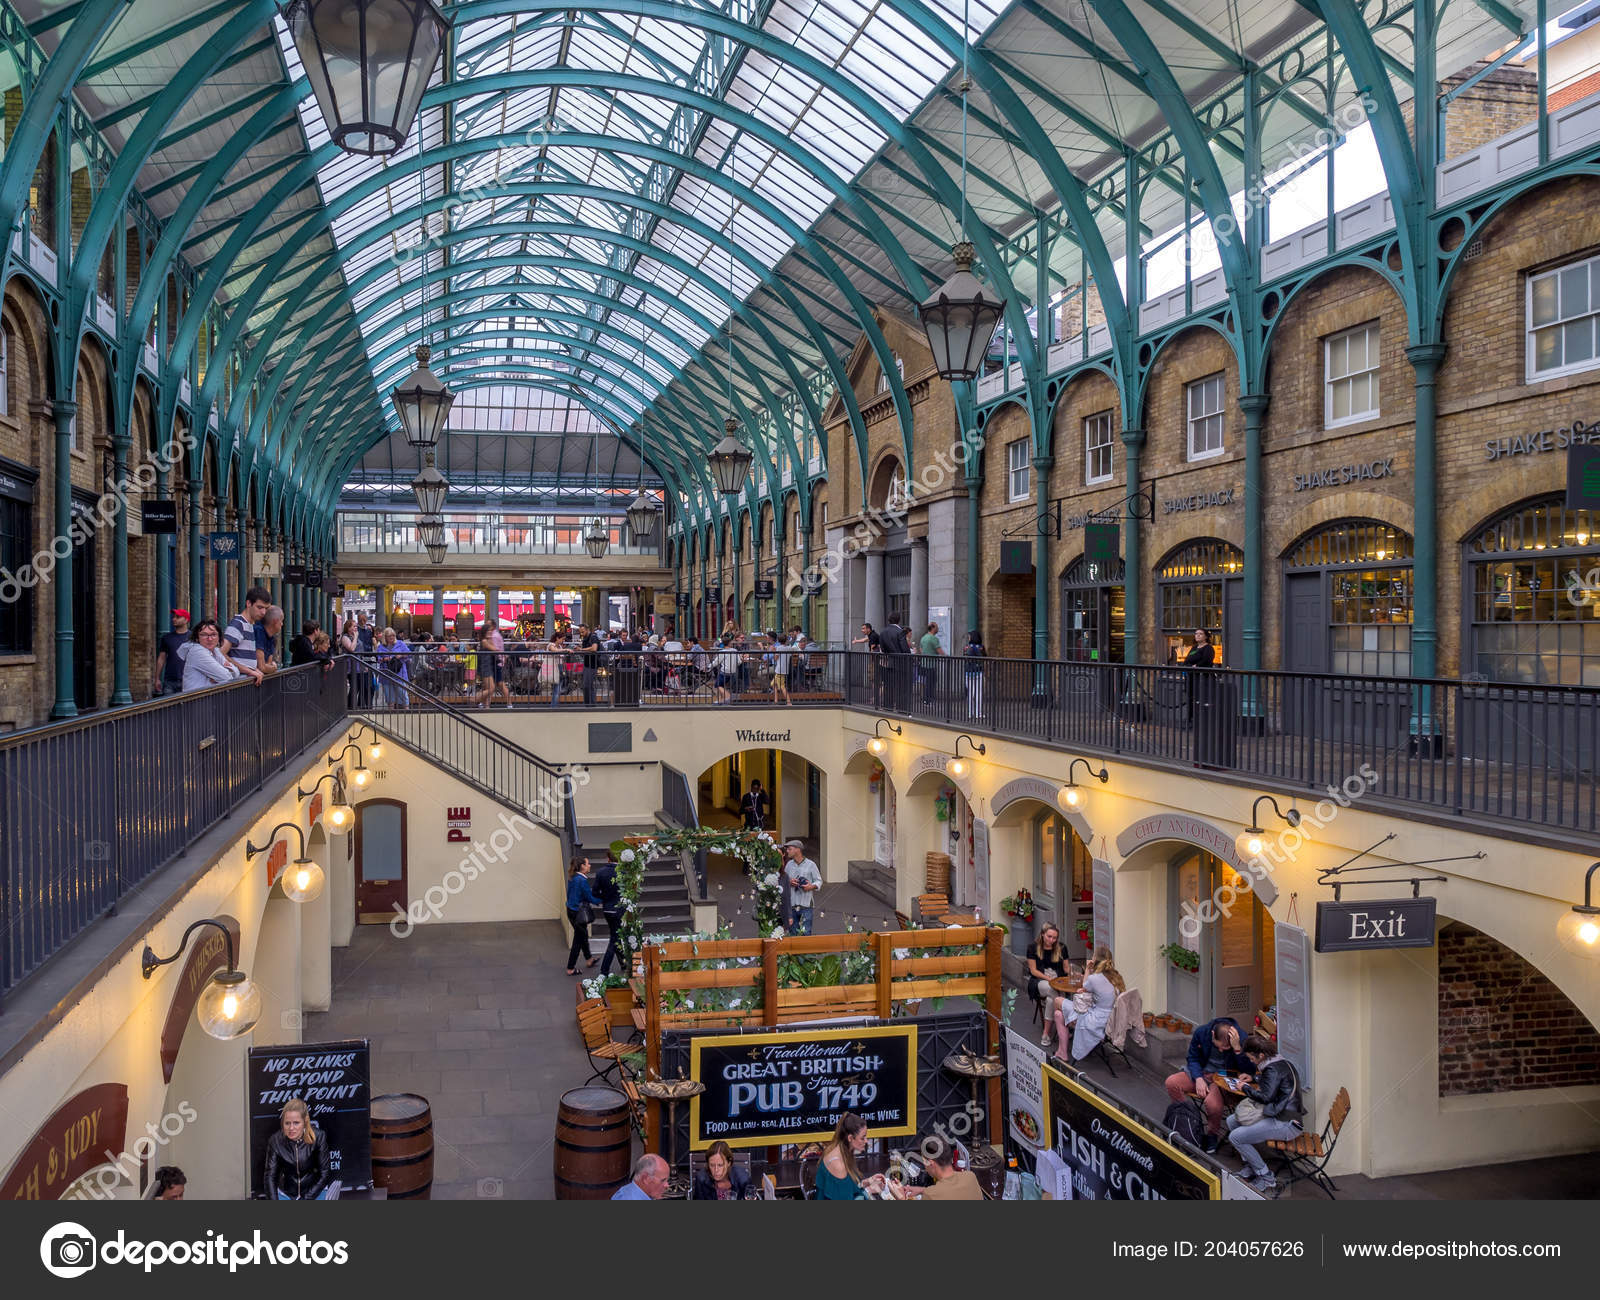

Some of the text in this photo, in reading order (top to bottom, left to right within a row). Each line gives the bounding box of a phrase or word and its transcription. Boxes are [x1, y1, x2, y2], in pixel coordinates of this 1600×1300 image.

[1484, 429, 1555, 461] SHAKE
[1294, 457, 1394, 491] SHAKE SHACK
[1163, 487, 1234, 514] SHAKE SHACK
[735, 730, 791, 742] Whittard
[1135, 819, 1162, 840] CHEZ
[1348, 910, 1407, 940] Exit
[262, 1052, 357, 1073] NO DRINKS
[762, 1041, 851, 1061] Traditional
[274, 1069, 346, 1088] BEYOND
[722, 1055, 885, 1081] GREAT BRITISH
[259, 1083, 363, 1105] THIS POINT
[807, 1075, 838, 1091] Since
[312, 1103, 336, 1118] You
[728, 1081, 878, 1117] PUB 1749
[705, 1121, 729, 1135] FOOD
[730, 1121, 742, 1131] ALL
[761, 1119, 778, 1128] REAL
[778, 1116, 802, 1129] ALES
[806, 1115, 827, 1125] CRAFT
[860, 1112, 876, 1121] FINE
[877, 1109, 901, 1121] WINE
[46, 1146, 58, 1186] &
[61, 1107, 102, 1180] JUDY
[1057, 1116, 1105, 1181] FISH
[1110, 1162, 1122, 1190] &
[1091, 1118, 1154, 1172] Our Ultimate
